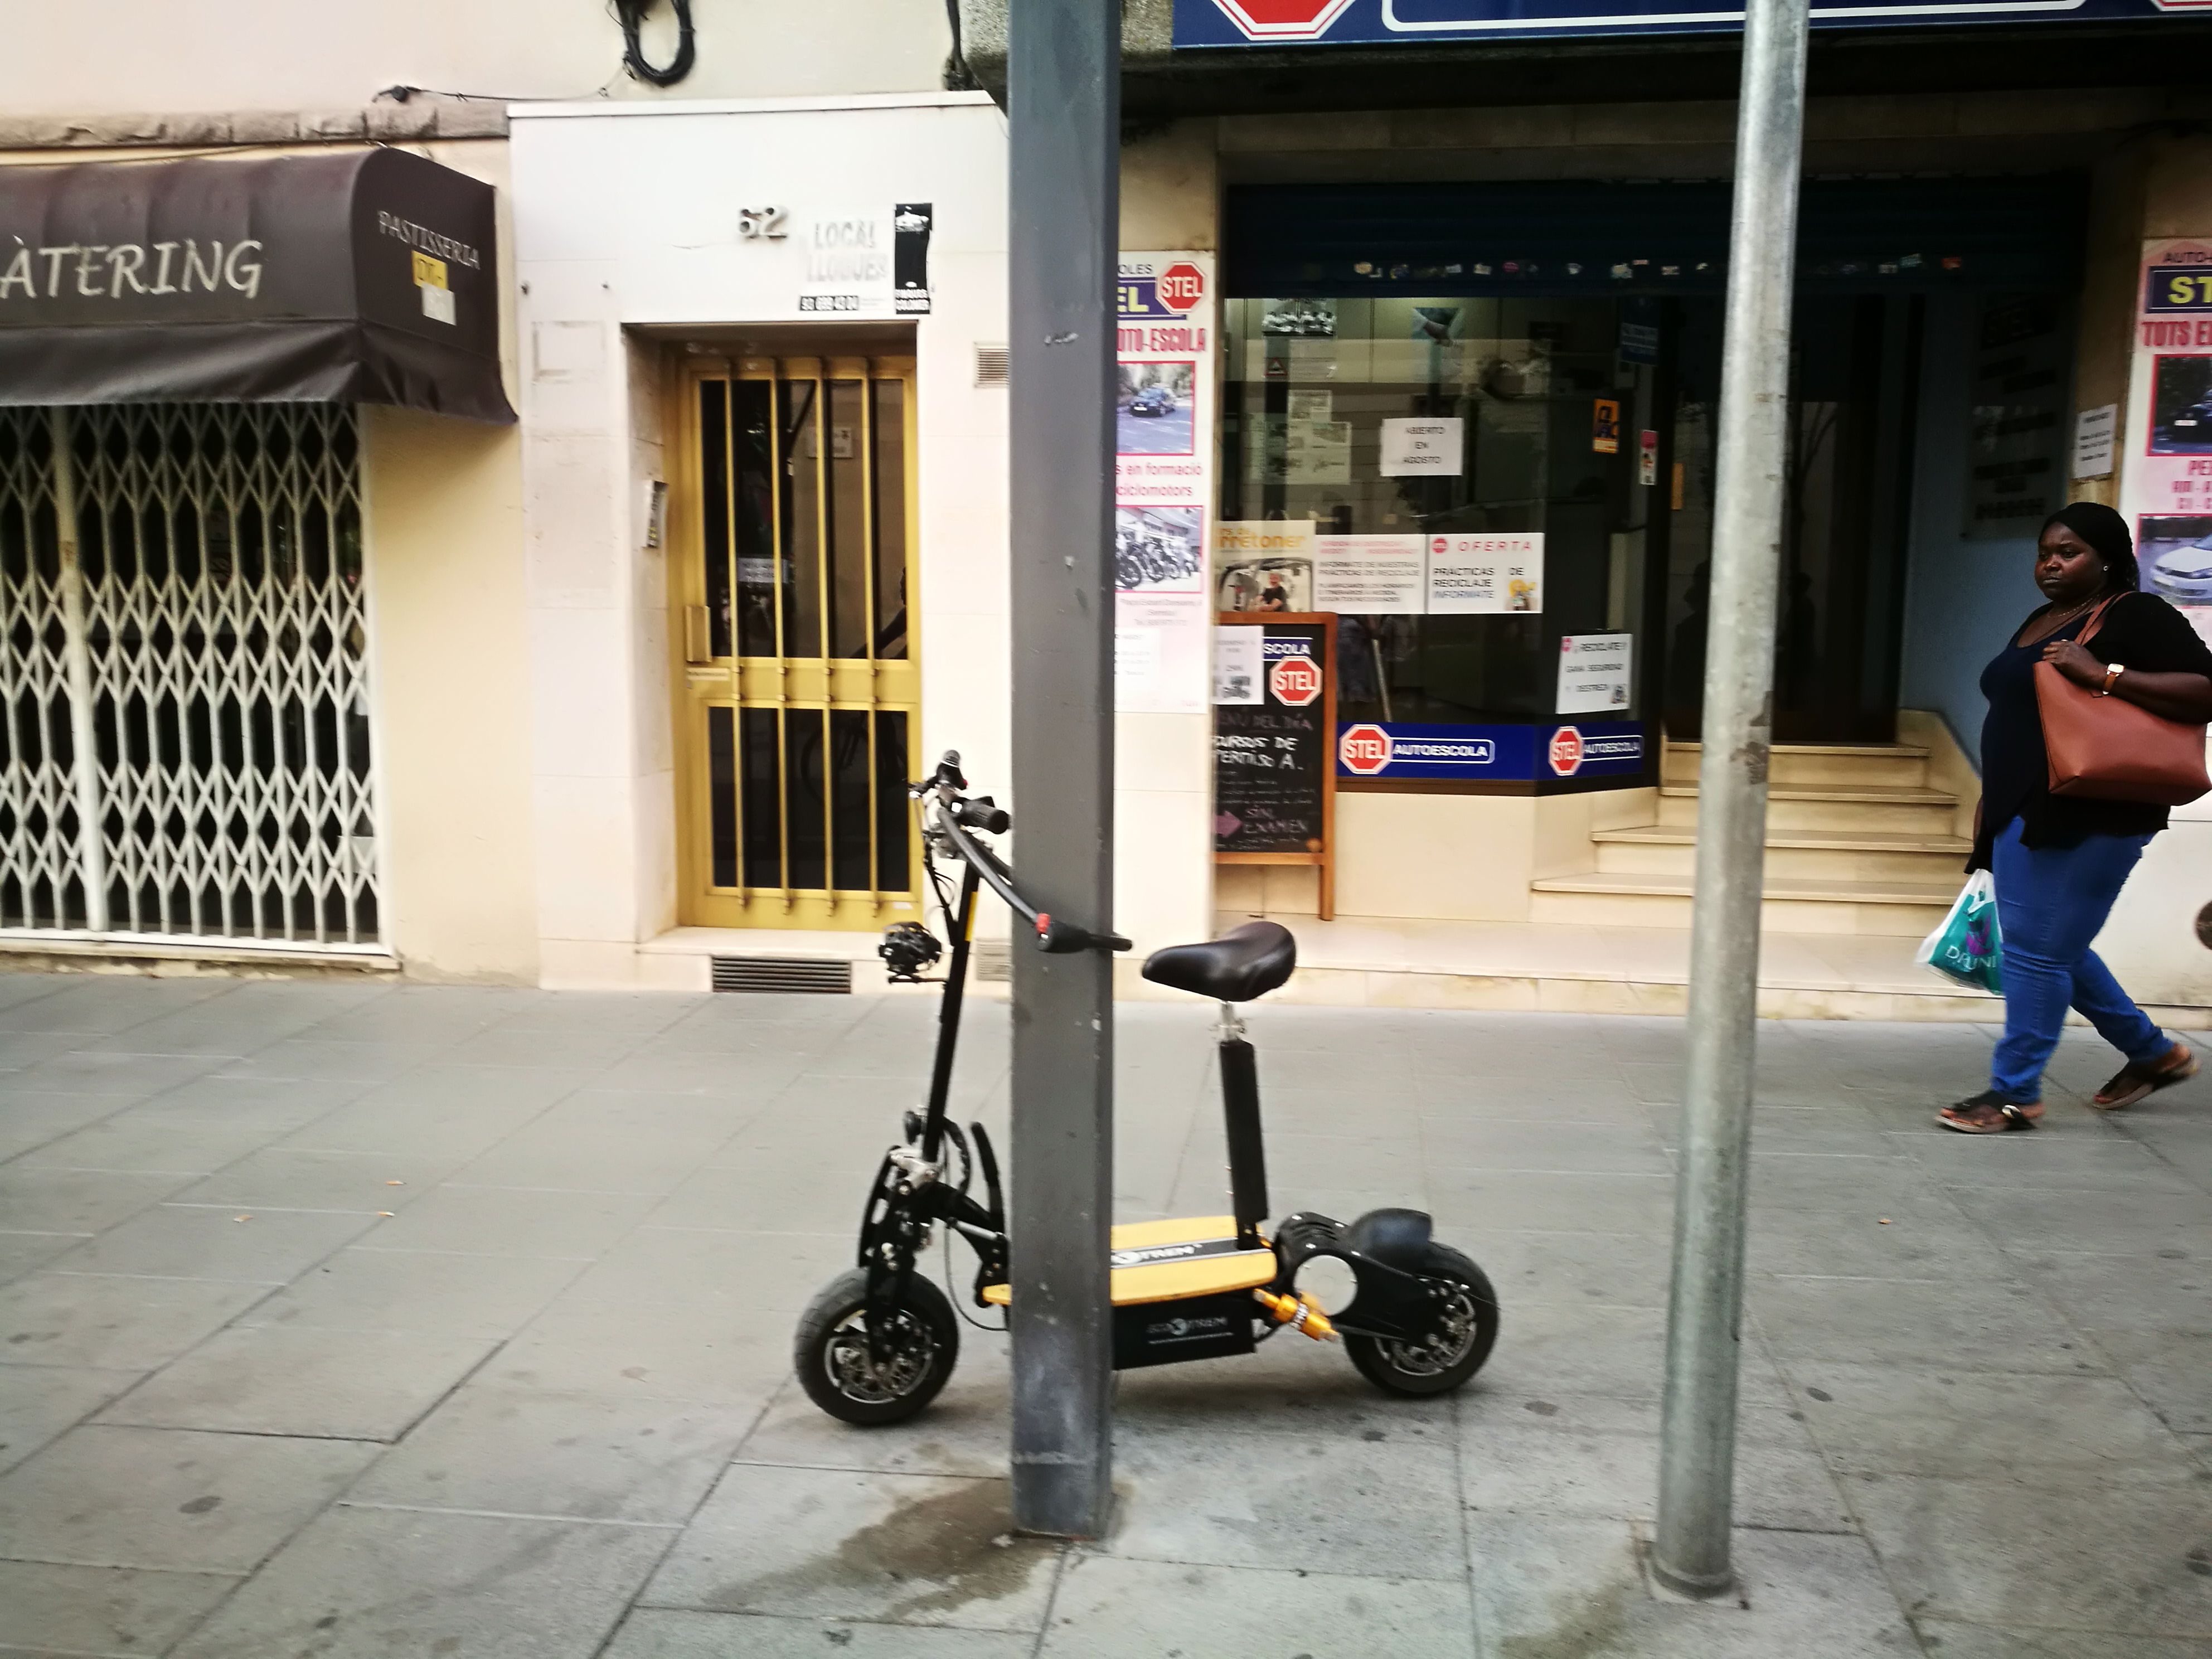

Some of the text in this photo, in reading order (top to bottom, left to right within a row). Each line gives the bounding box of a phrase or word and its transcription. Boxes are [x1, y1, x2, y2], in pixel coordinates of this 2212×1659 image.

[377, 210, 481, 270] PASTISSERIA
[814, 221, 876, 248] LOCAL
[1160, 276, 1203, 298] STEL
[1127, 466, 1143, 476] en
[1457, 541, 1531, 552] OFERTA
[1508, 567, 1525, 576] DE
[1433, 579, 1495, 588] RECICLAJE
[1274, 670, 1317, 691] STEL
[1274, 736, 1299, 751] DE
[1343, 739, 1488, 759] STEL AUTOESCOLA
[1551, 741, 1641, 761] STEL AUTOESCOLA
